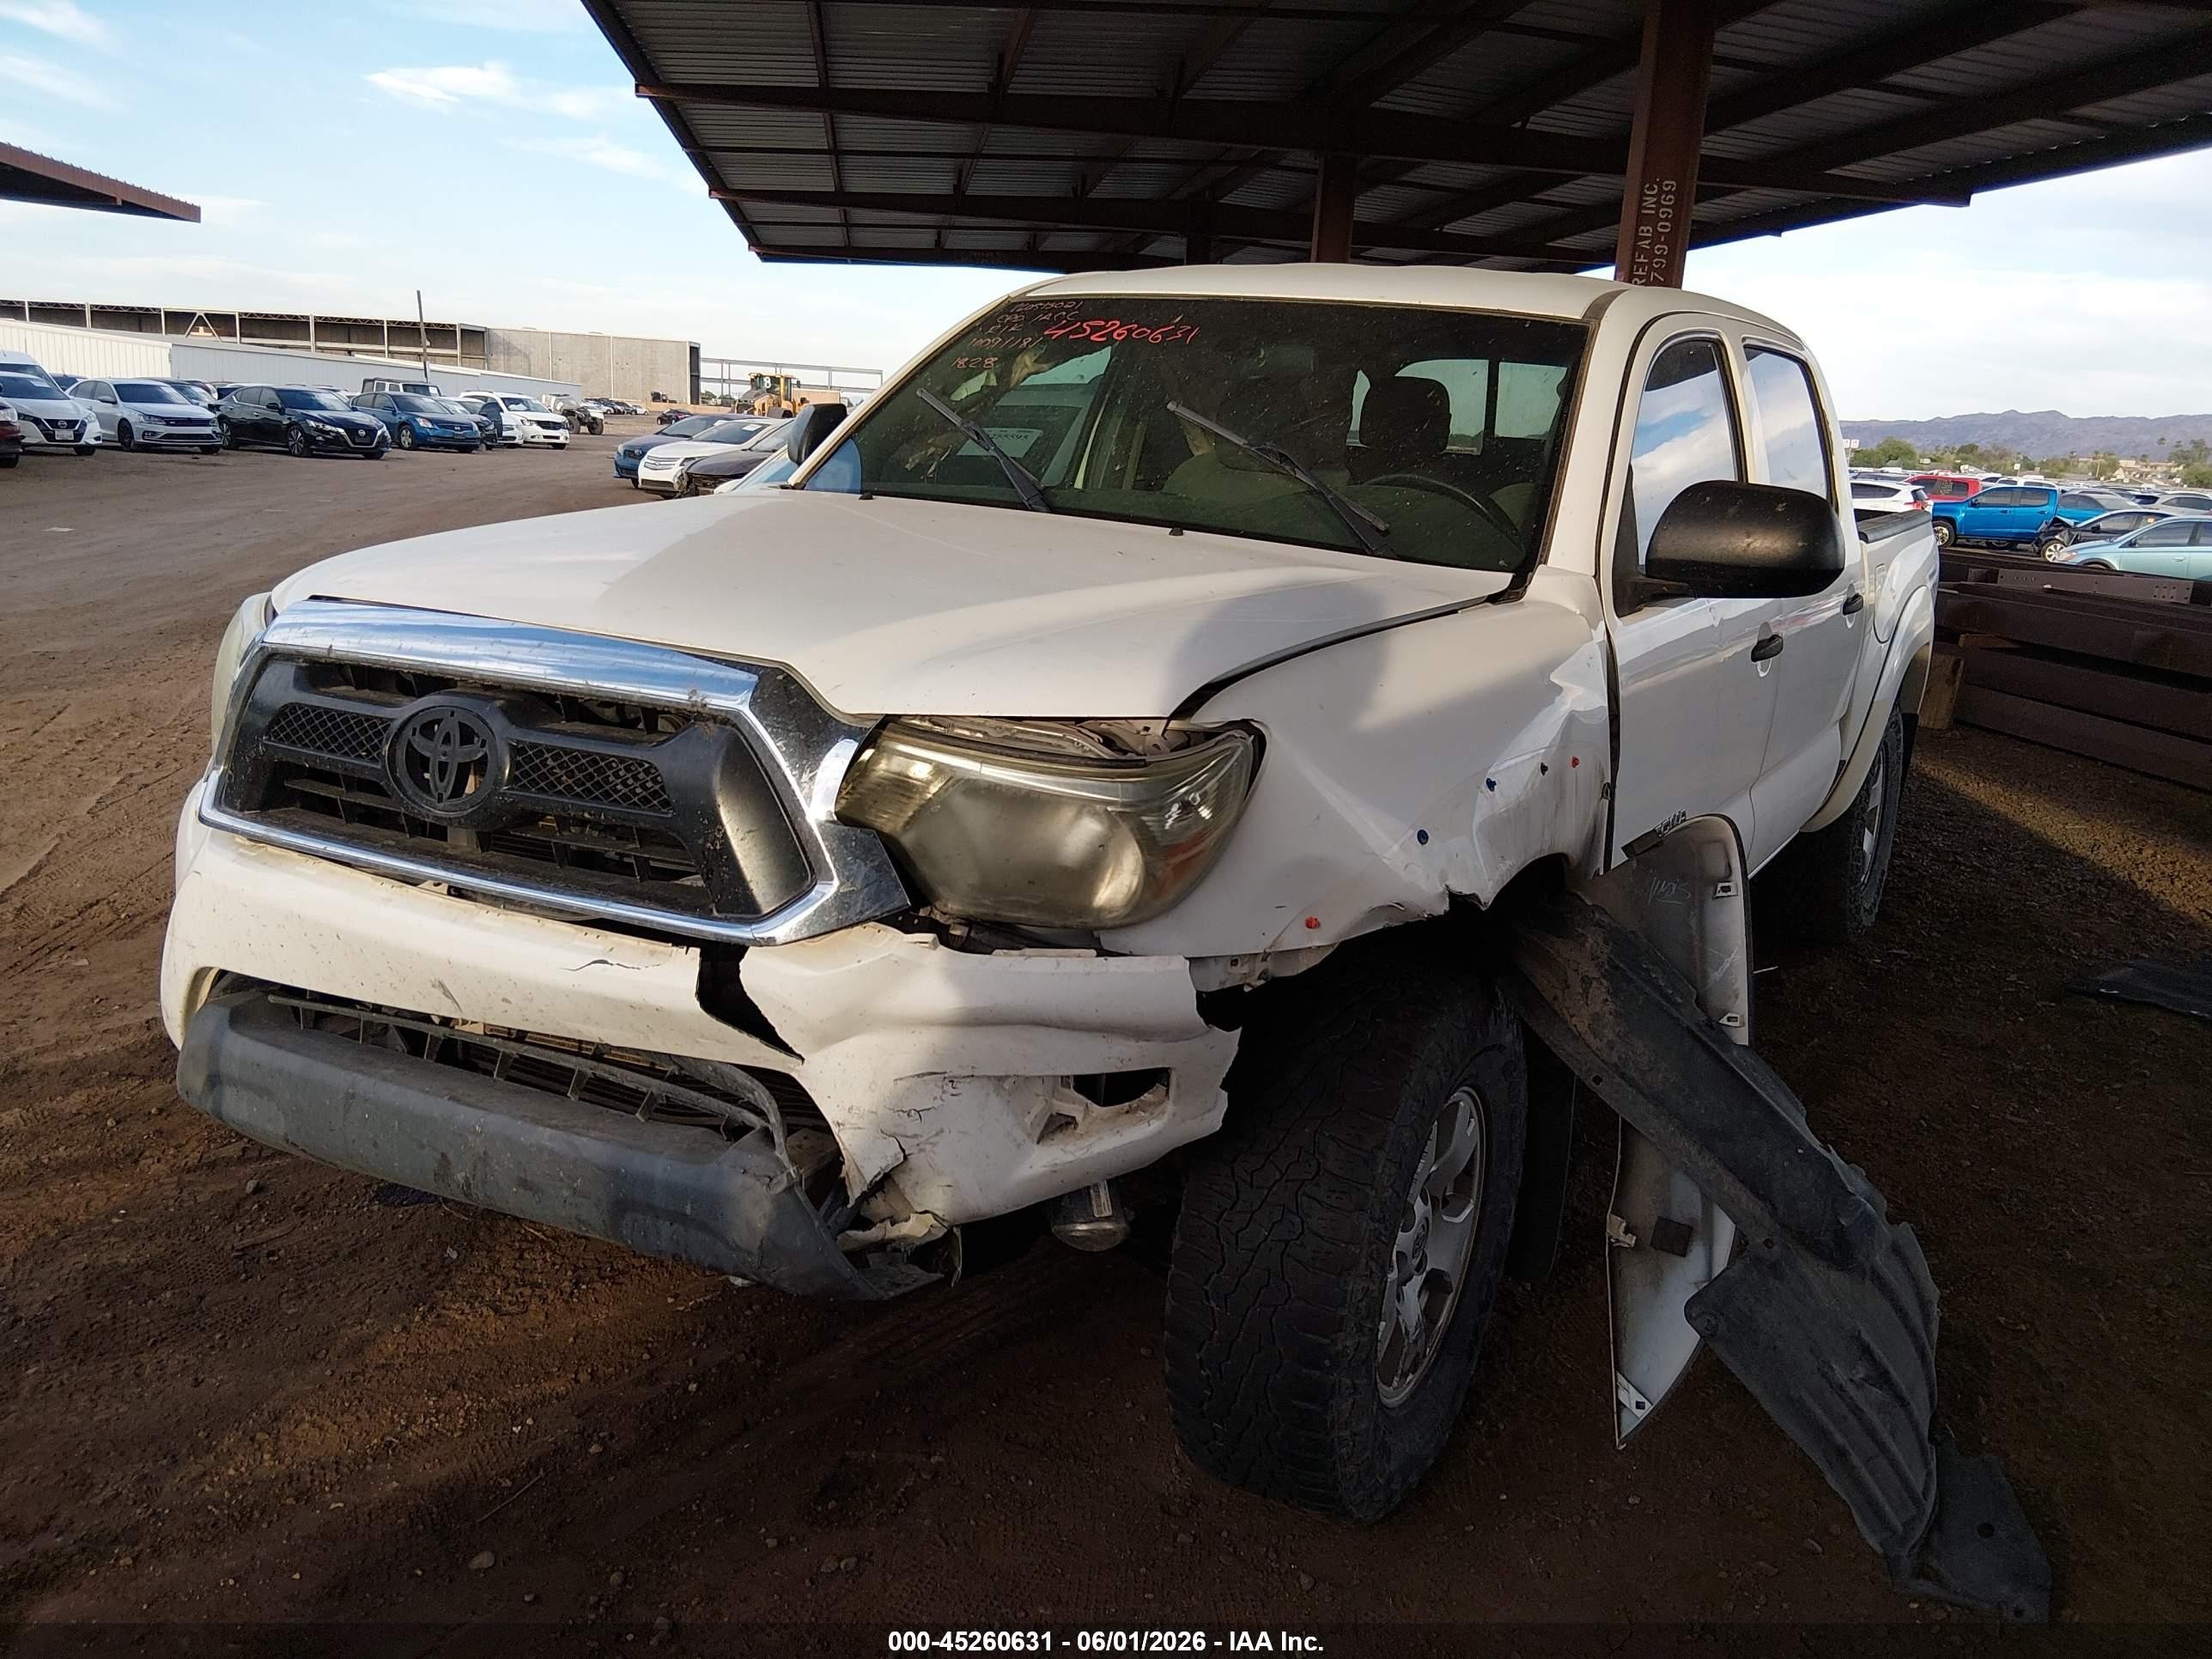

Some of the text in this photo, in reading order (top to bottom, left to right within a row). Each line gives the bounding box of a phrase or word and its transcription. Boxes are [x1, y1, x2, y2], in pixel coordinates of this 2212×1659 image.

[1632, 178, 1660, 285] REFAB INC.
[1650, 179, 1677, 282] 799-0969
[1043, 319, 1200, 344] 45260631
